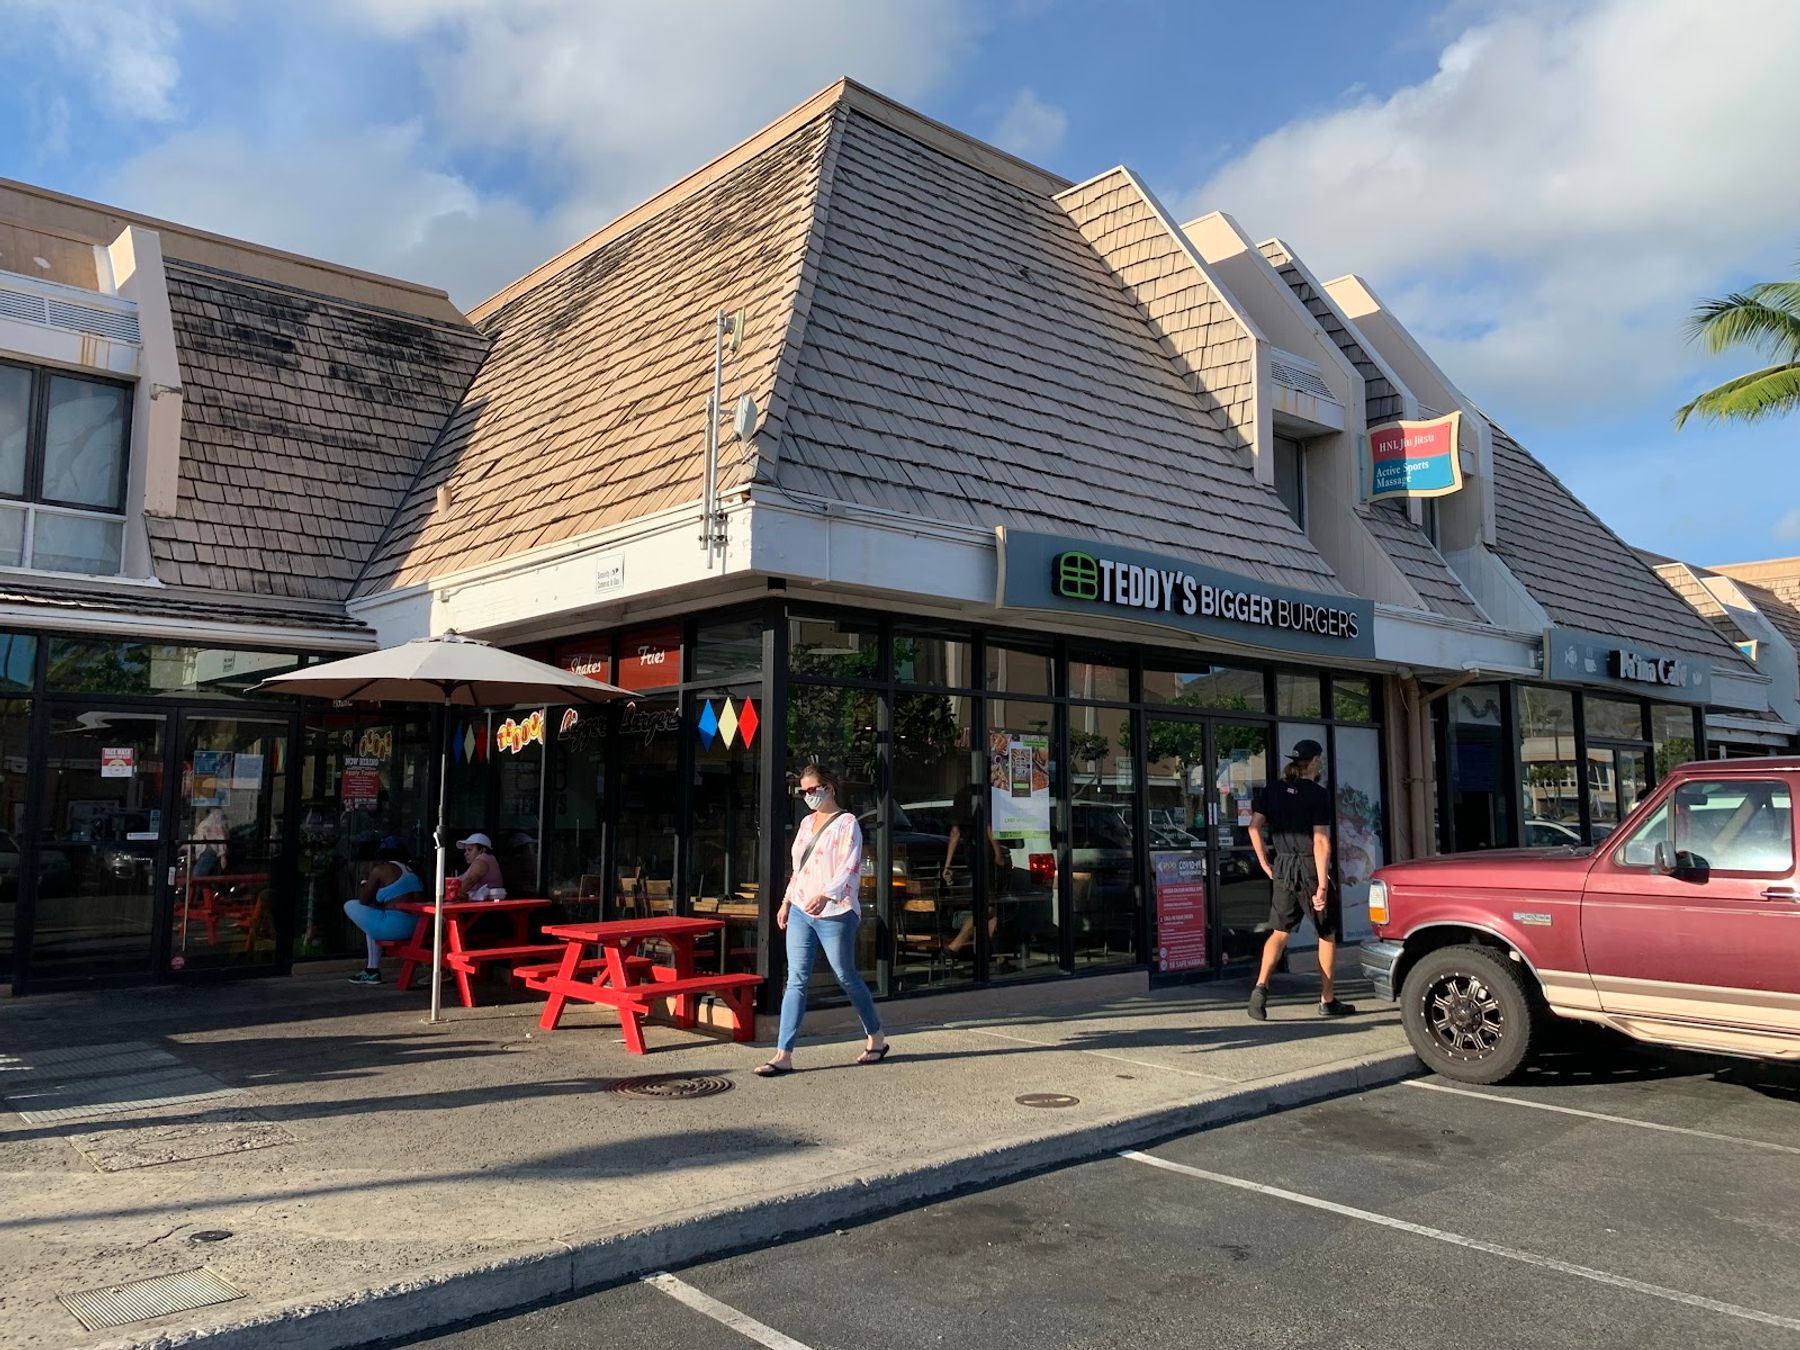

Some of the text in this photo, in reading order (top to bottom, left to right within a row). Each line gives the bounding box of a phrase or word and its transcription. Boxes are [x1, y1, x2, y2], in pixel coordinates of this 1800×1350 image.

[1379, 434, 1435, 453] HNL Jiu Jitsu
[1376, 461, 1429, 478] Active Sports
[1376, 475, 1412, 488] Massage
[1099, 559, 1359, 639] TEDDY'S BIGGER BURGERS
[571, 655, 601, 675] Shakes
[637, 646, 666, 667] Fries
